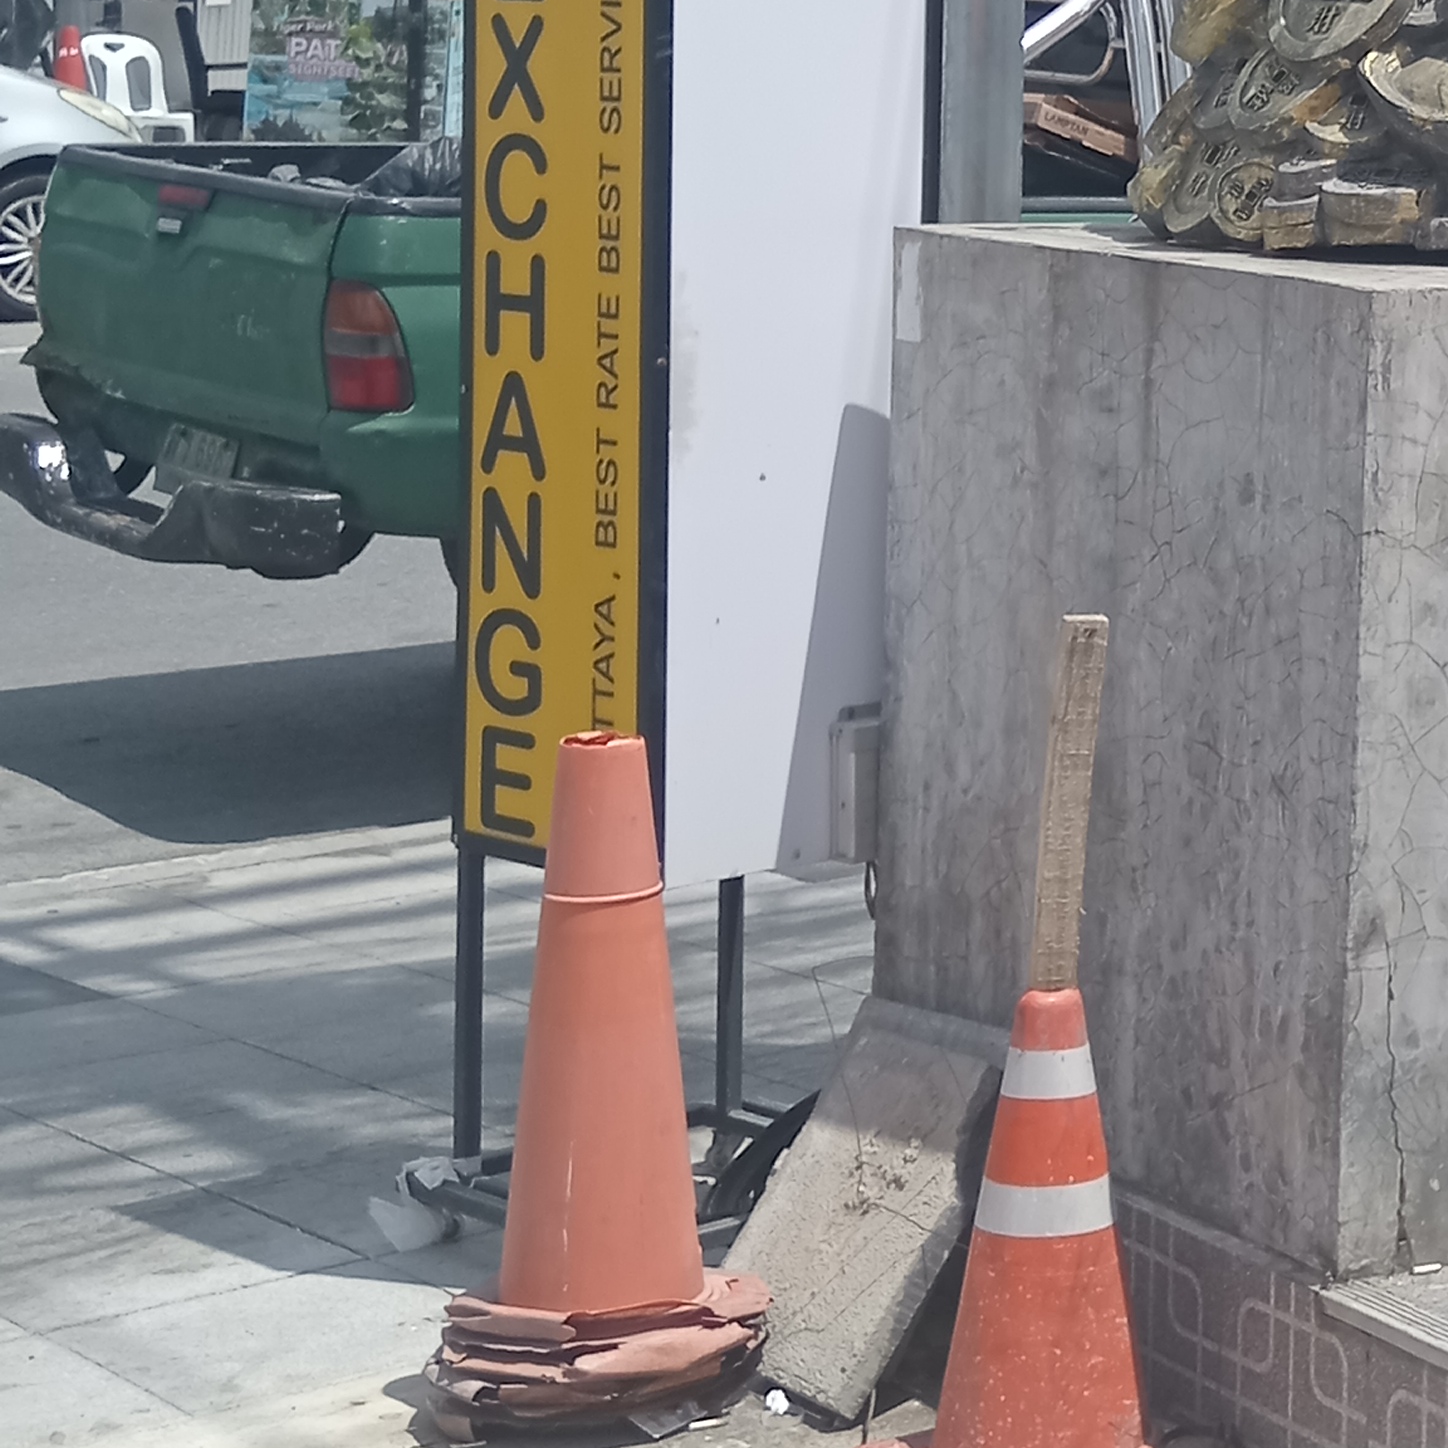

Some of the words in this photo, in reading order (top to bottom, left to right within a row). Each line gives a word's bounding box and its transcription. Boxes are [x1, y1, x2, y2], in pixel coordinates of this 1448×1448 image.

[288, 62, 361, 79] SIGHTSEE
[597, 151, 621, 275] BEST
[595, 291, 620, 411] RATE
[594, 427, 619, 550] BEST
[592, 593, 618, 732] TTAYA
